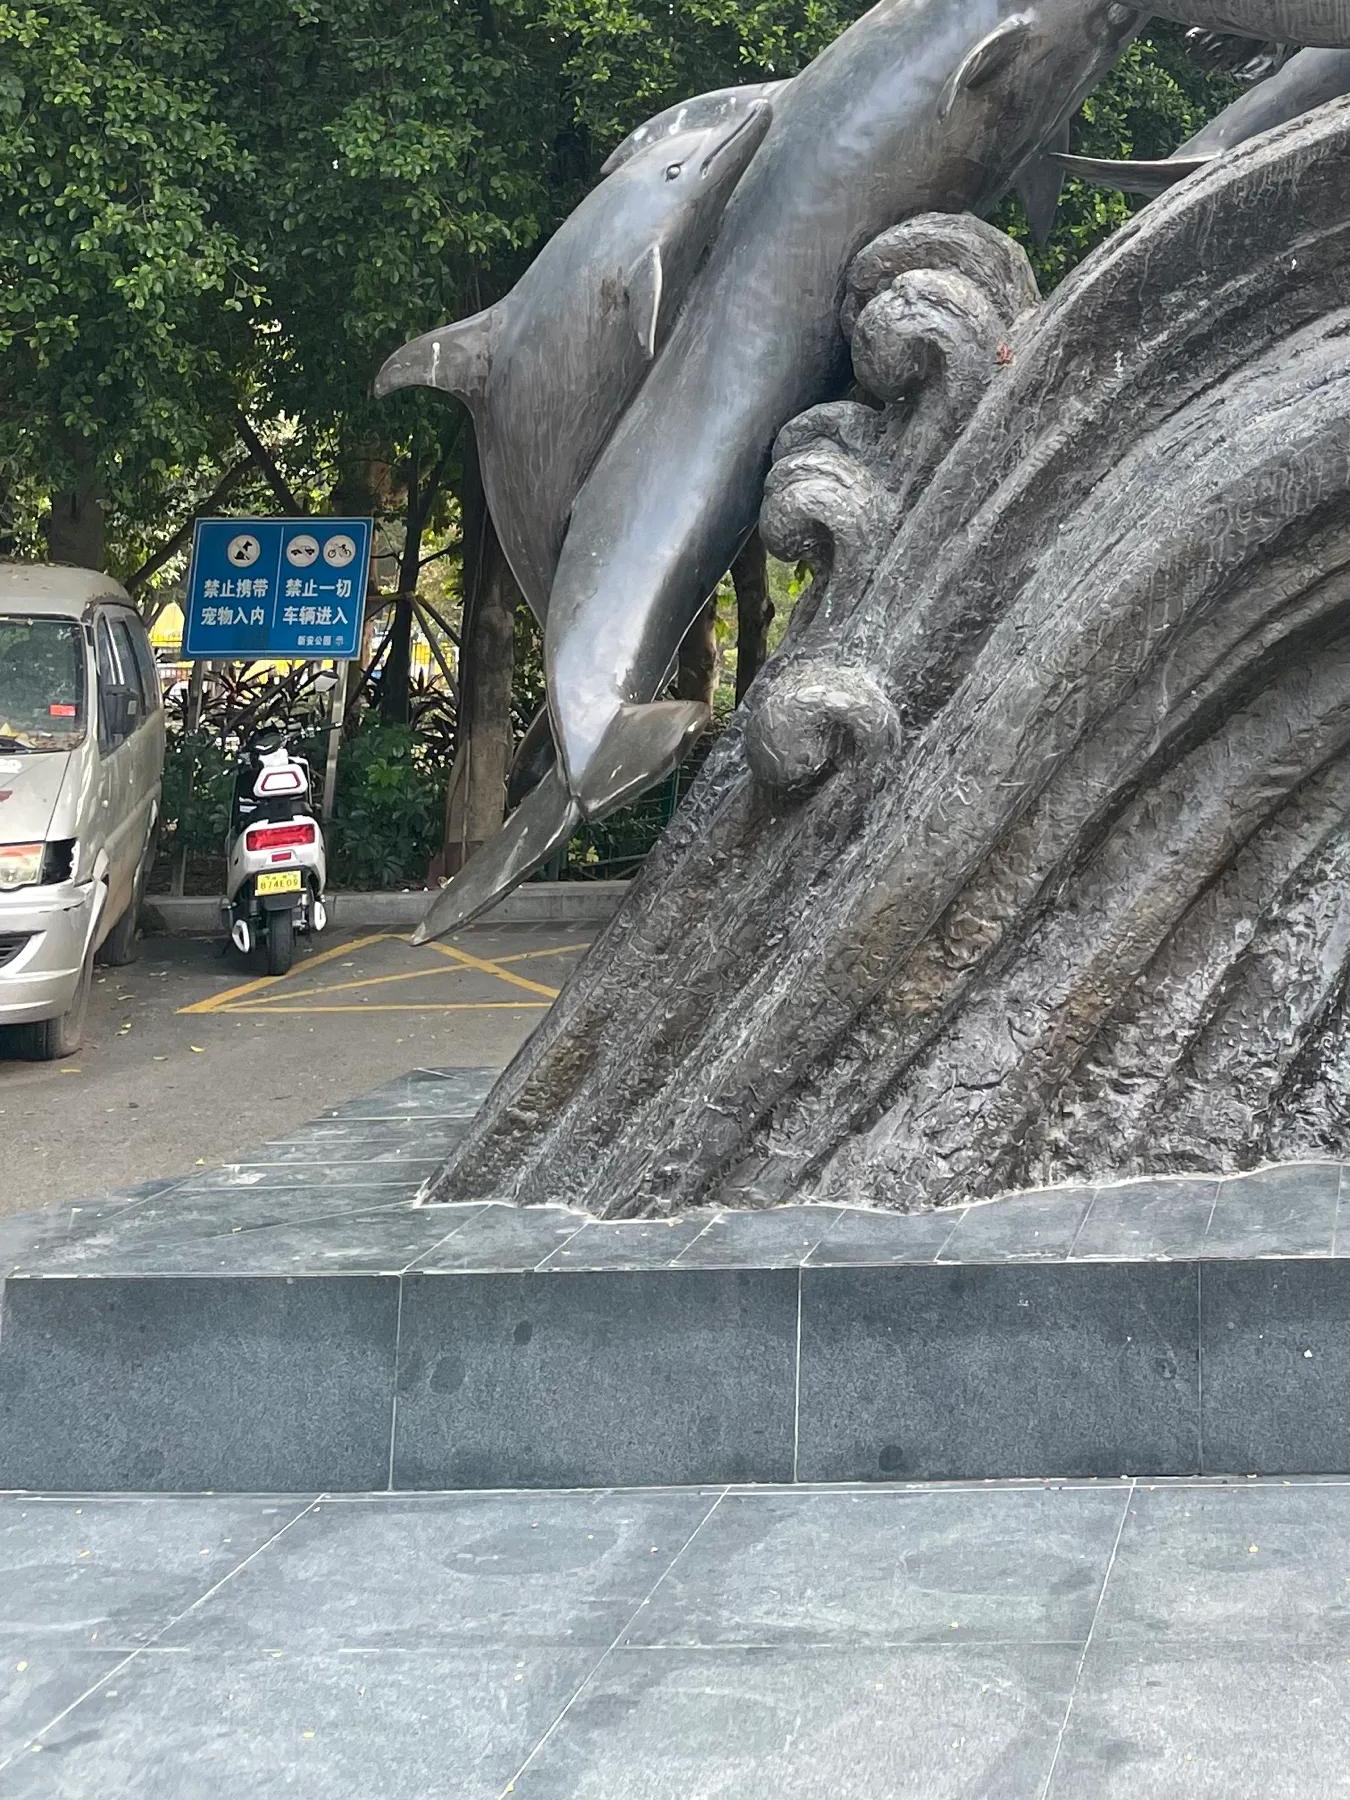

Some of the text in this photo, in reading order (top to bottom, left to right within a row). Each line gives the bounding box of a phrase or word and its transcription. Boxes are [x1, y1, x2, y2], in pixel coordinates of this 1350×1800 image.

[203, 578, 268, 598] 禁止携带
[285, 578, 352, 598] 禁止一切
[201, 606, 265, 626] 宠物入内
[283, 606, 348, 626] 车辆进入
